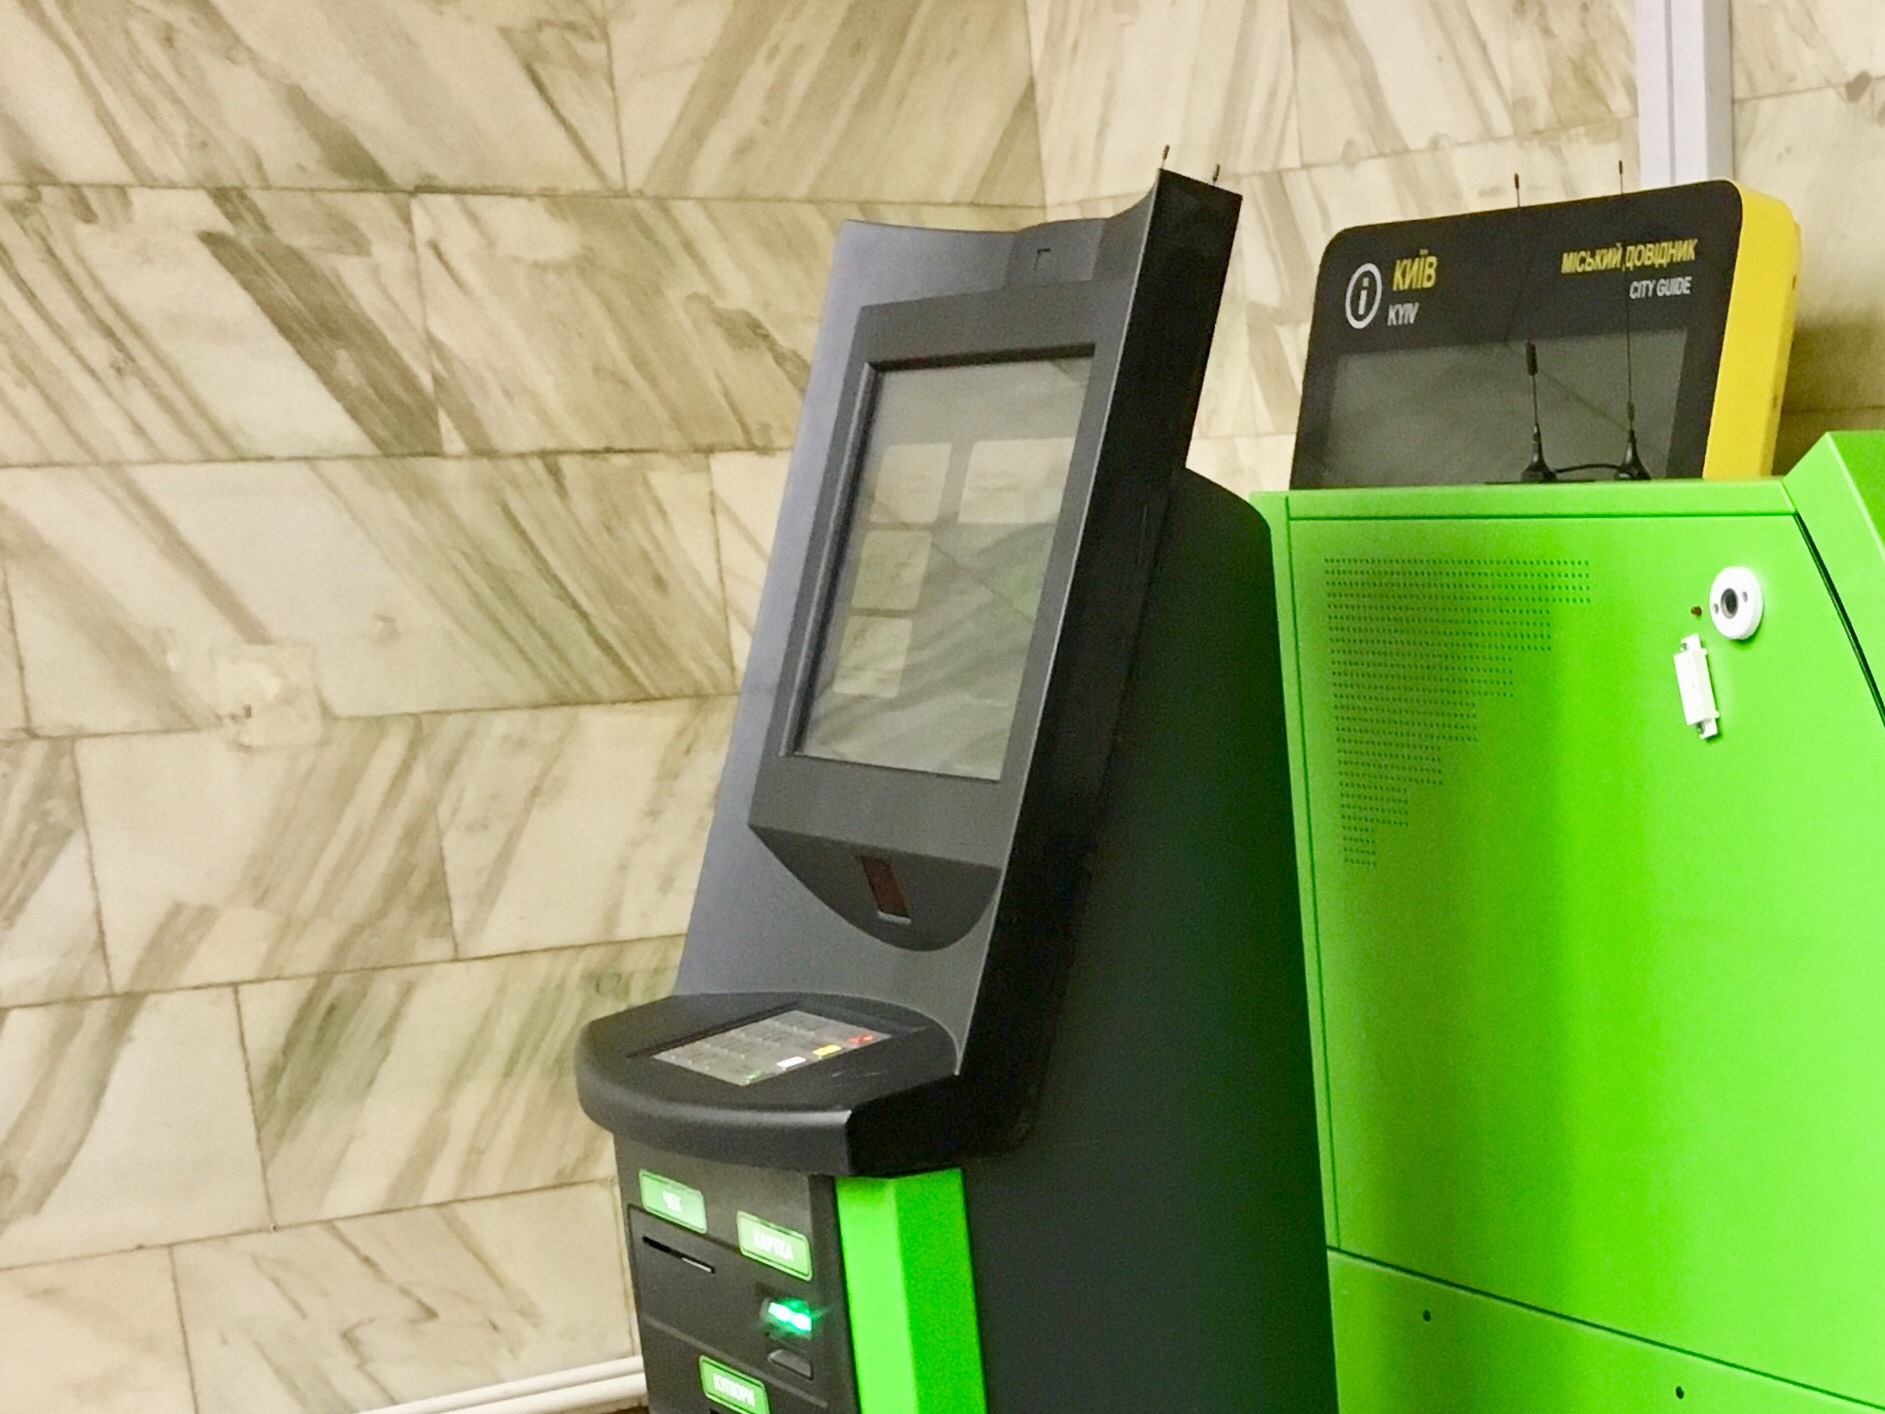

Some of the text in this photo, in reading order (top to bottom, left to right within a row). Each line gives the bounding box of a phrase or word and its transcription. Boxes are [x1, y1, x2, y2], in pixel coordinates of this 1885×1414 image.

[1392, 249, 1438, 292] КИЇВ
[1561, 239, 1697, 274] МІСЬКИЙ ДОВІДНИК
[1629, 276, 1692, 300] CITY GUIDE
[1387, 302, 1419, 327] KYIV
